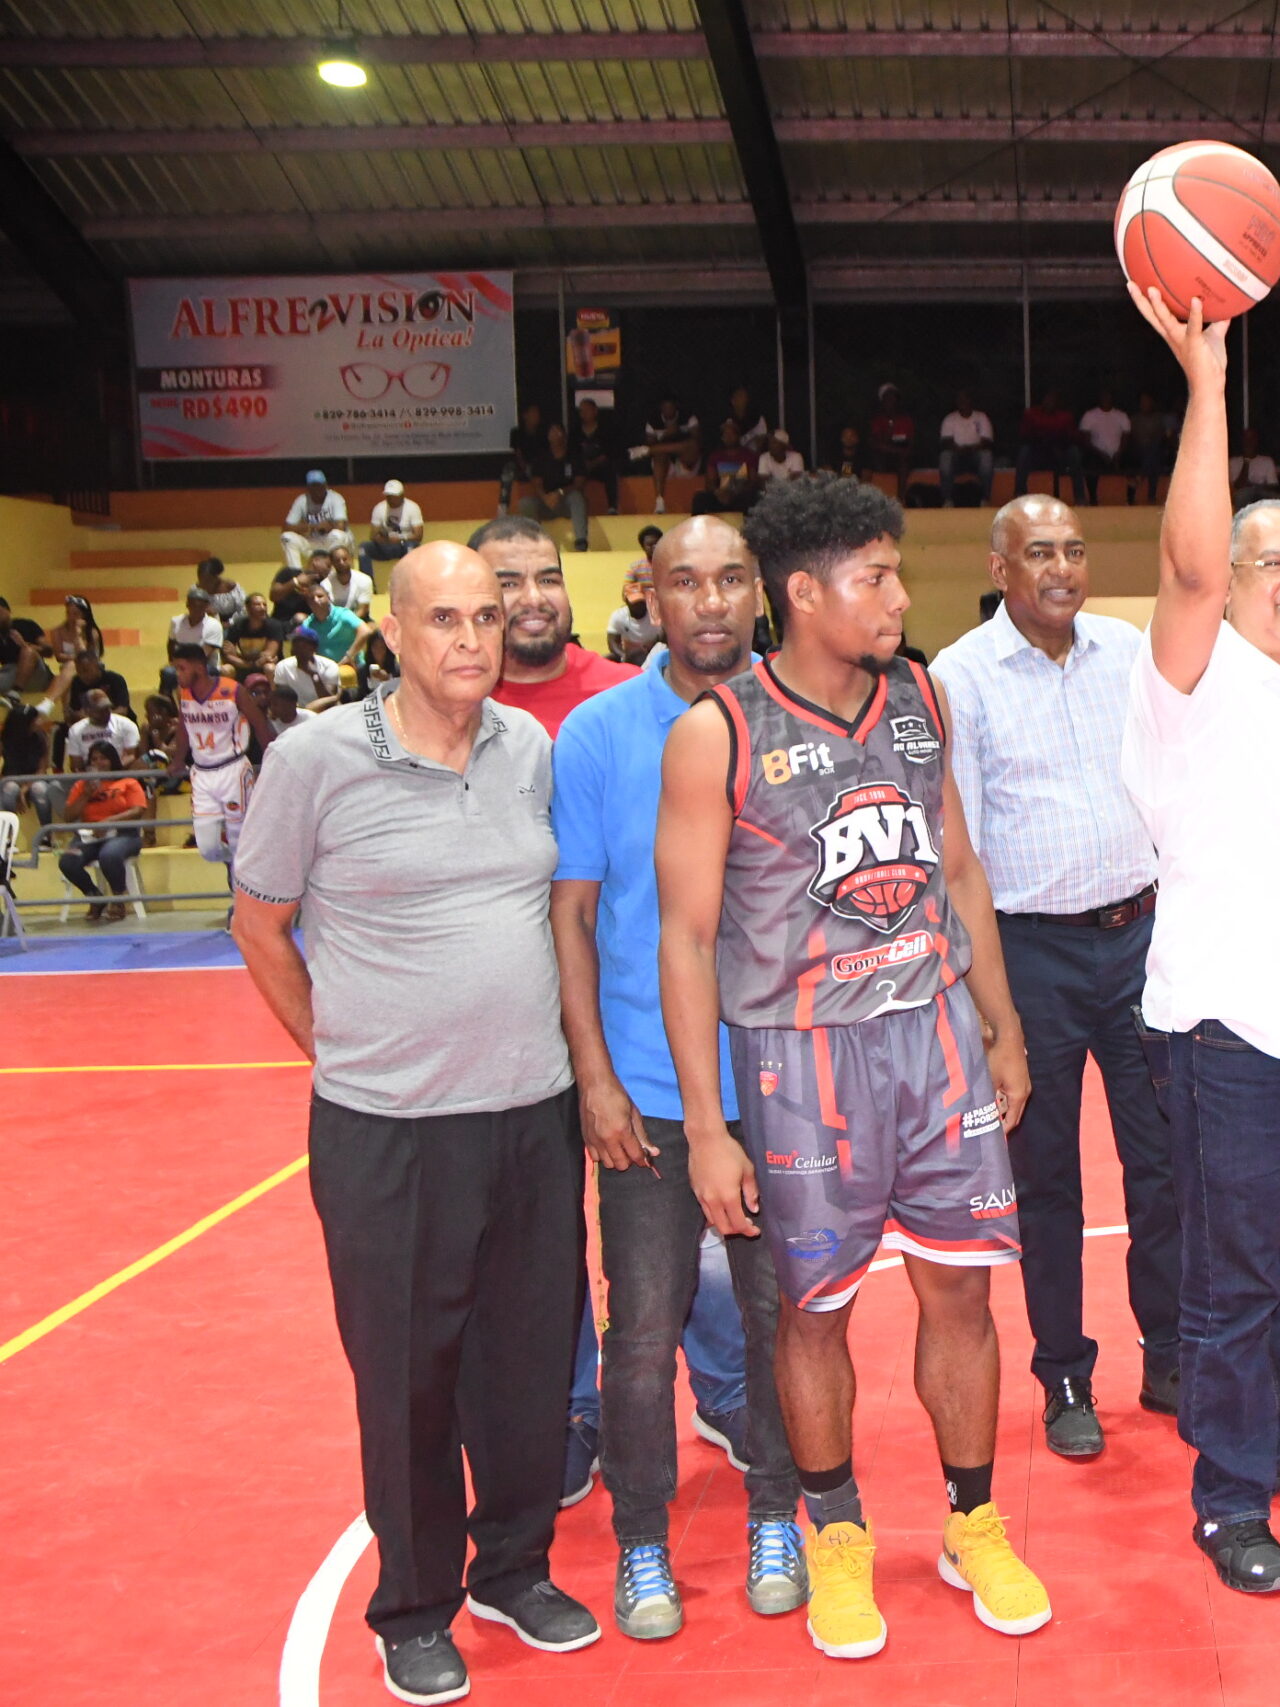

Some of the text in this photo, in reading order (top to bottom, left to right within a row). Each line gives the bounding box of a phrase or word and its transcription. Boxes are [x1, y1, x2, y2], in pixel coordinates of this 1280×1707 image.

[356, 327, 474, 353] La Optica!
[160, 368, 263, 390] MONTURAS
[182, 393, 268, 420] RD$490
[195, 731, 215, 750] 14
[761, 742, 835, 785] BFit
[766, 1151, 837, 1169] Emy Celular
